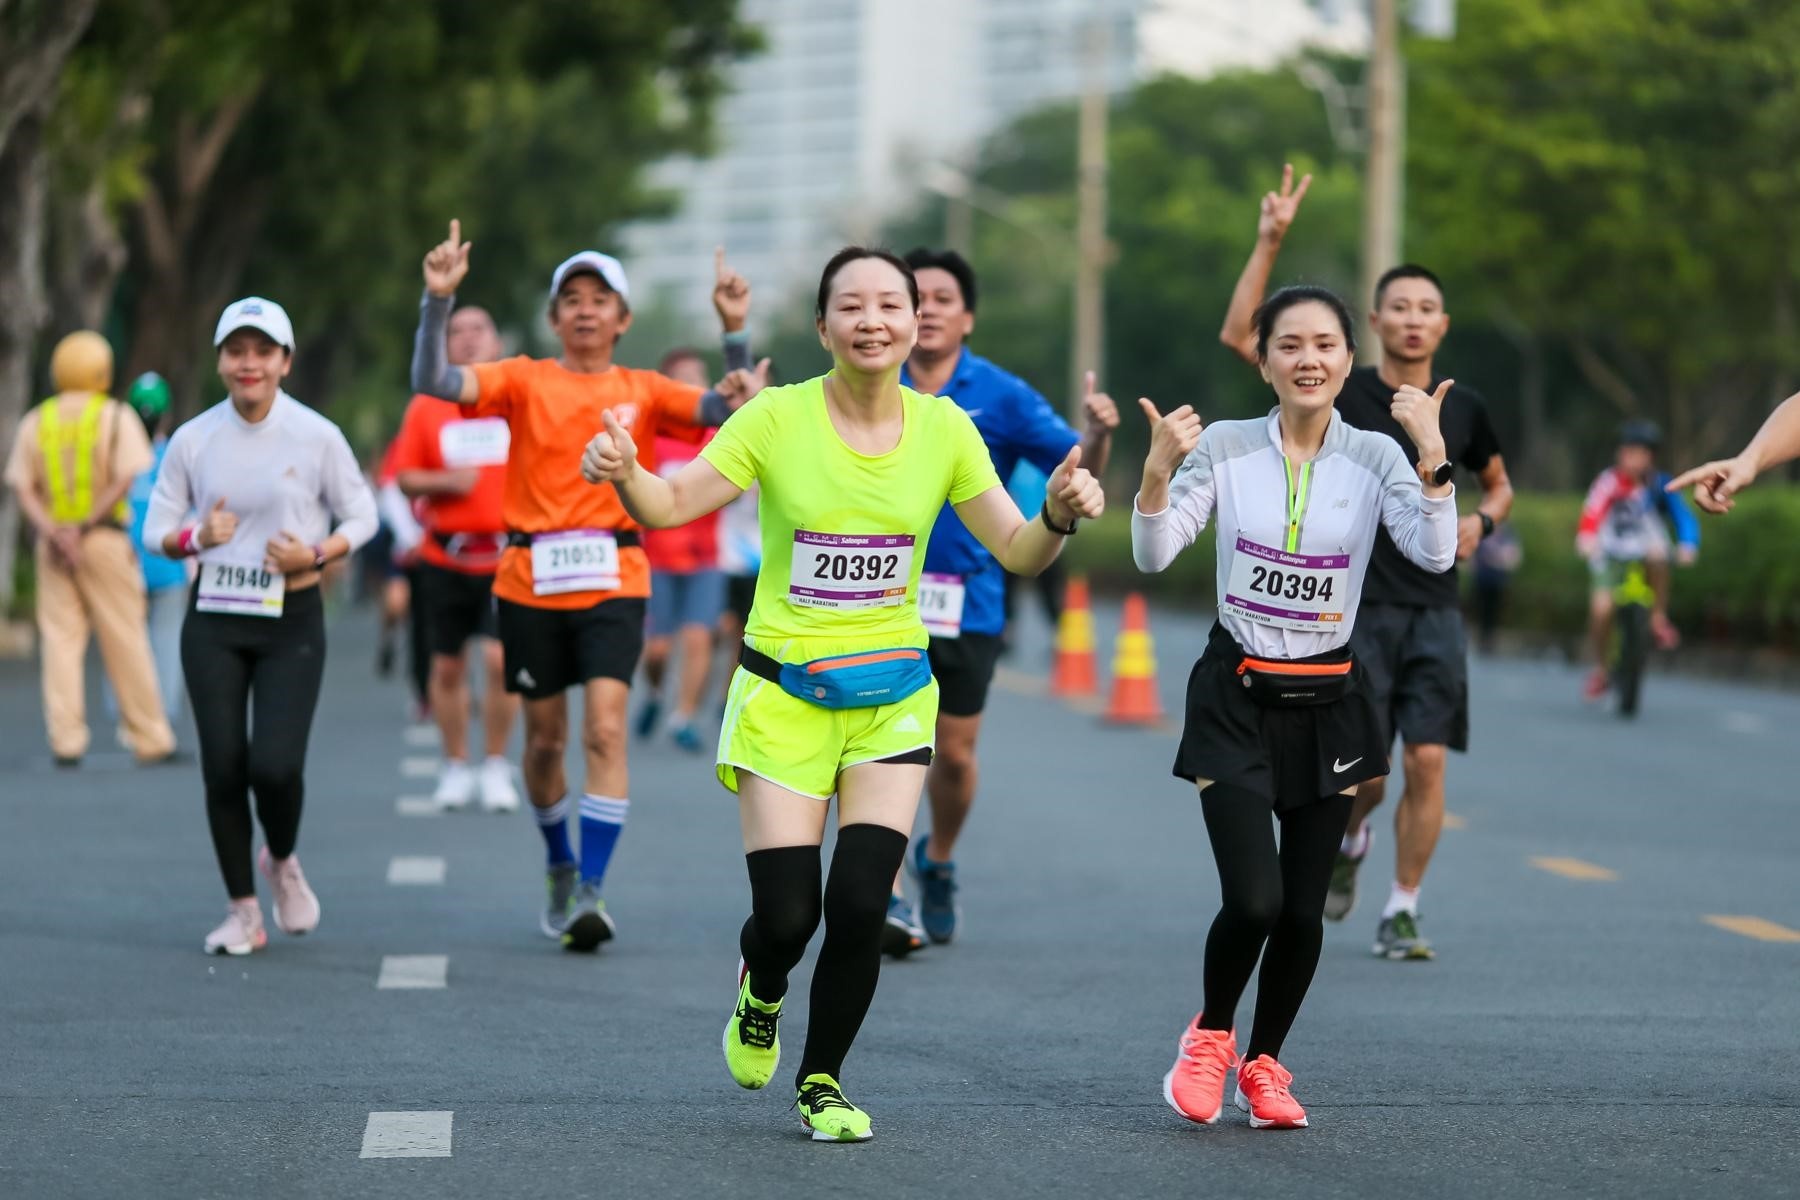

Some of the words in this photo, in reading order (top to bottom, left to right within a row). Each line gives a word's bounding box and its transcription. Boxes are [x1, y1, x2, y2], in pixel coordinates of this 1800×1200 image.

[841, 536, 869, 545] Salonpas
[551, 545, 606, 567] 21053
[1279, 553, 1307, 565] Salonpas
[814, 553, 898, 580] 20392
[216, 564, 272, 588] 21940
[1250, 565, 1333, 602] 20394
[812, 599, 838, 607] MARATHON
[1232, 608, 1245, 616] HALF
[1244, 611, 1271, 622] MARATHON
